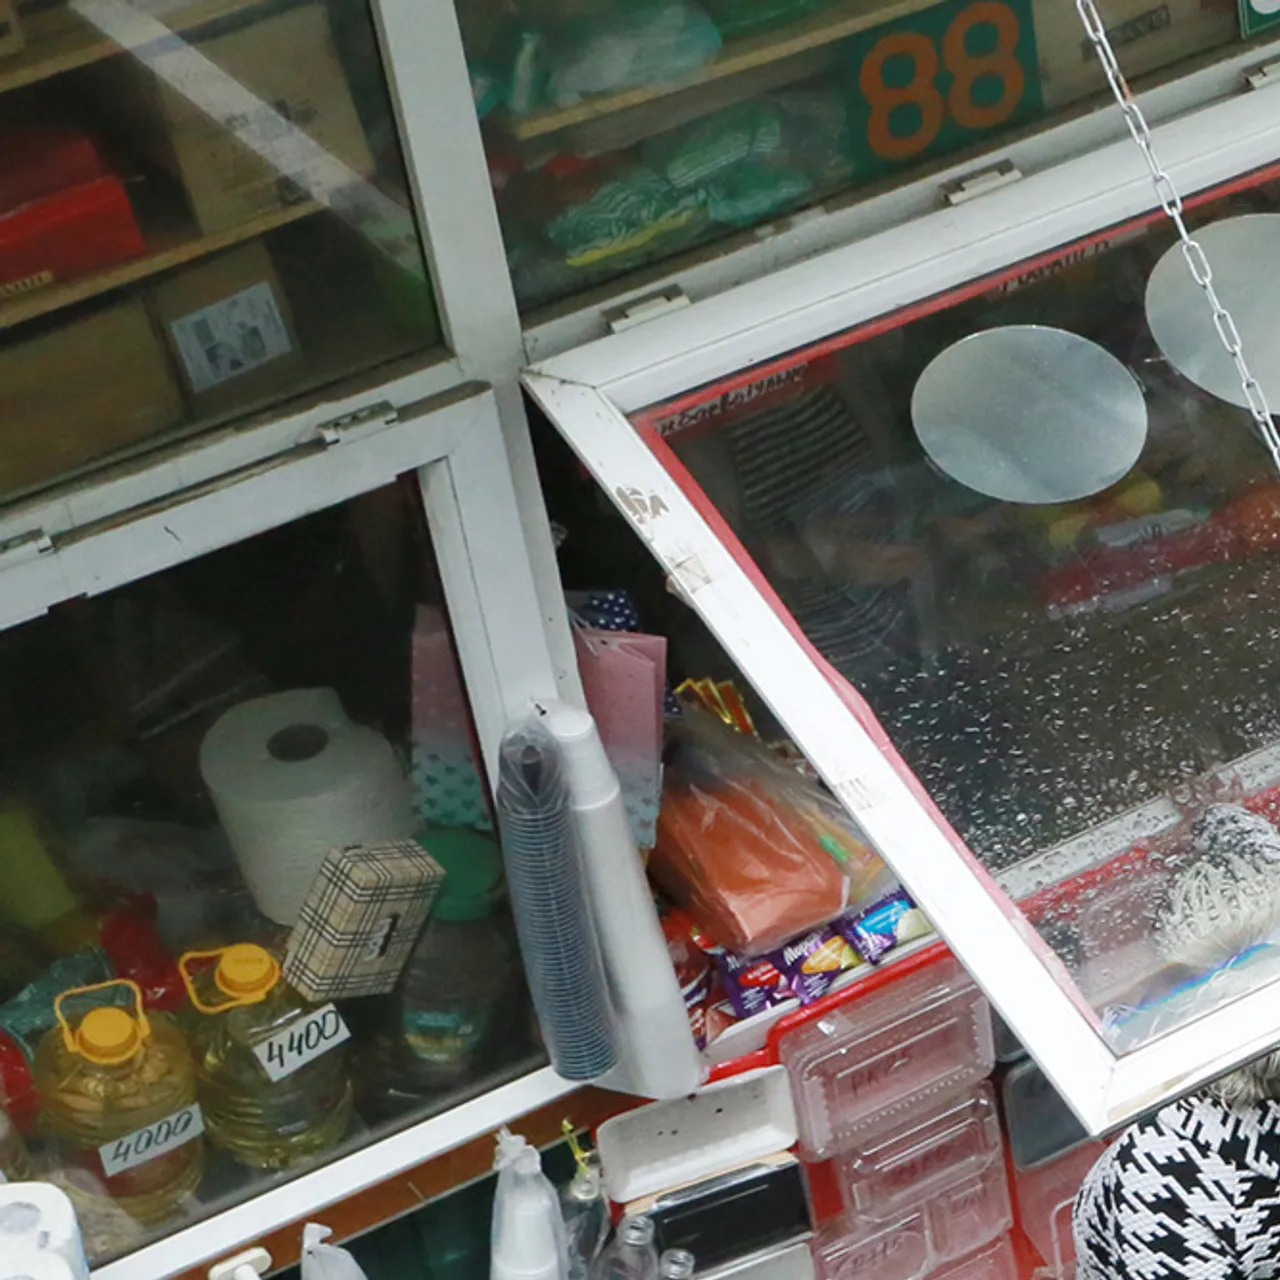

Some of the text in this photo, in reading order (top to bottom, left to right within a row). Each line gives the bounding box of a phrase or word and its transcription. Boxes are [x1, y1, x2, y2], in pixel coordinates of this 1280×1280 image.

[861, 3, 1024, 160] 88
[266, 1008, 341, 1068] 4400
[111, 1110, 194, 1163] 4000
